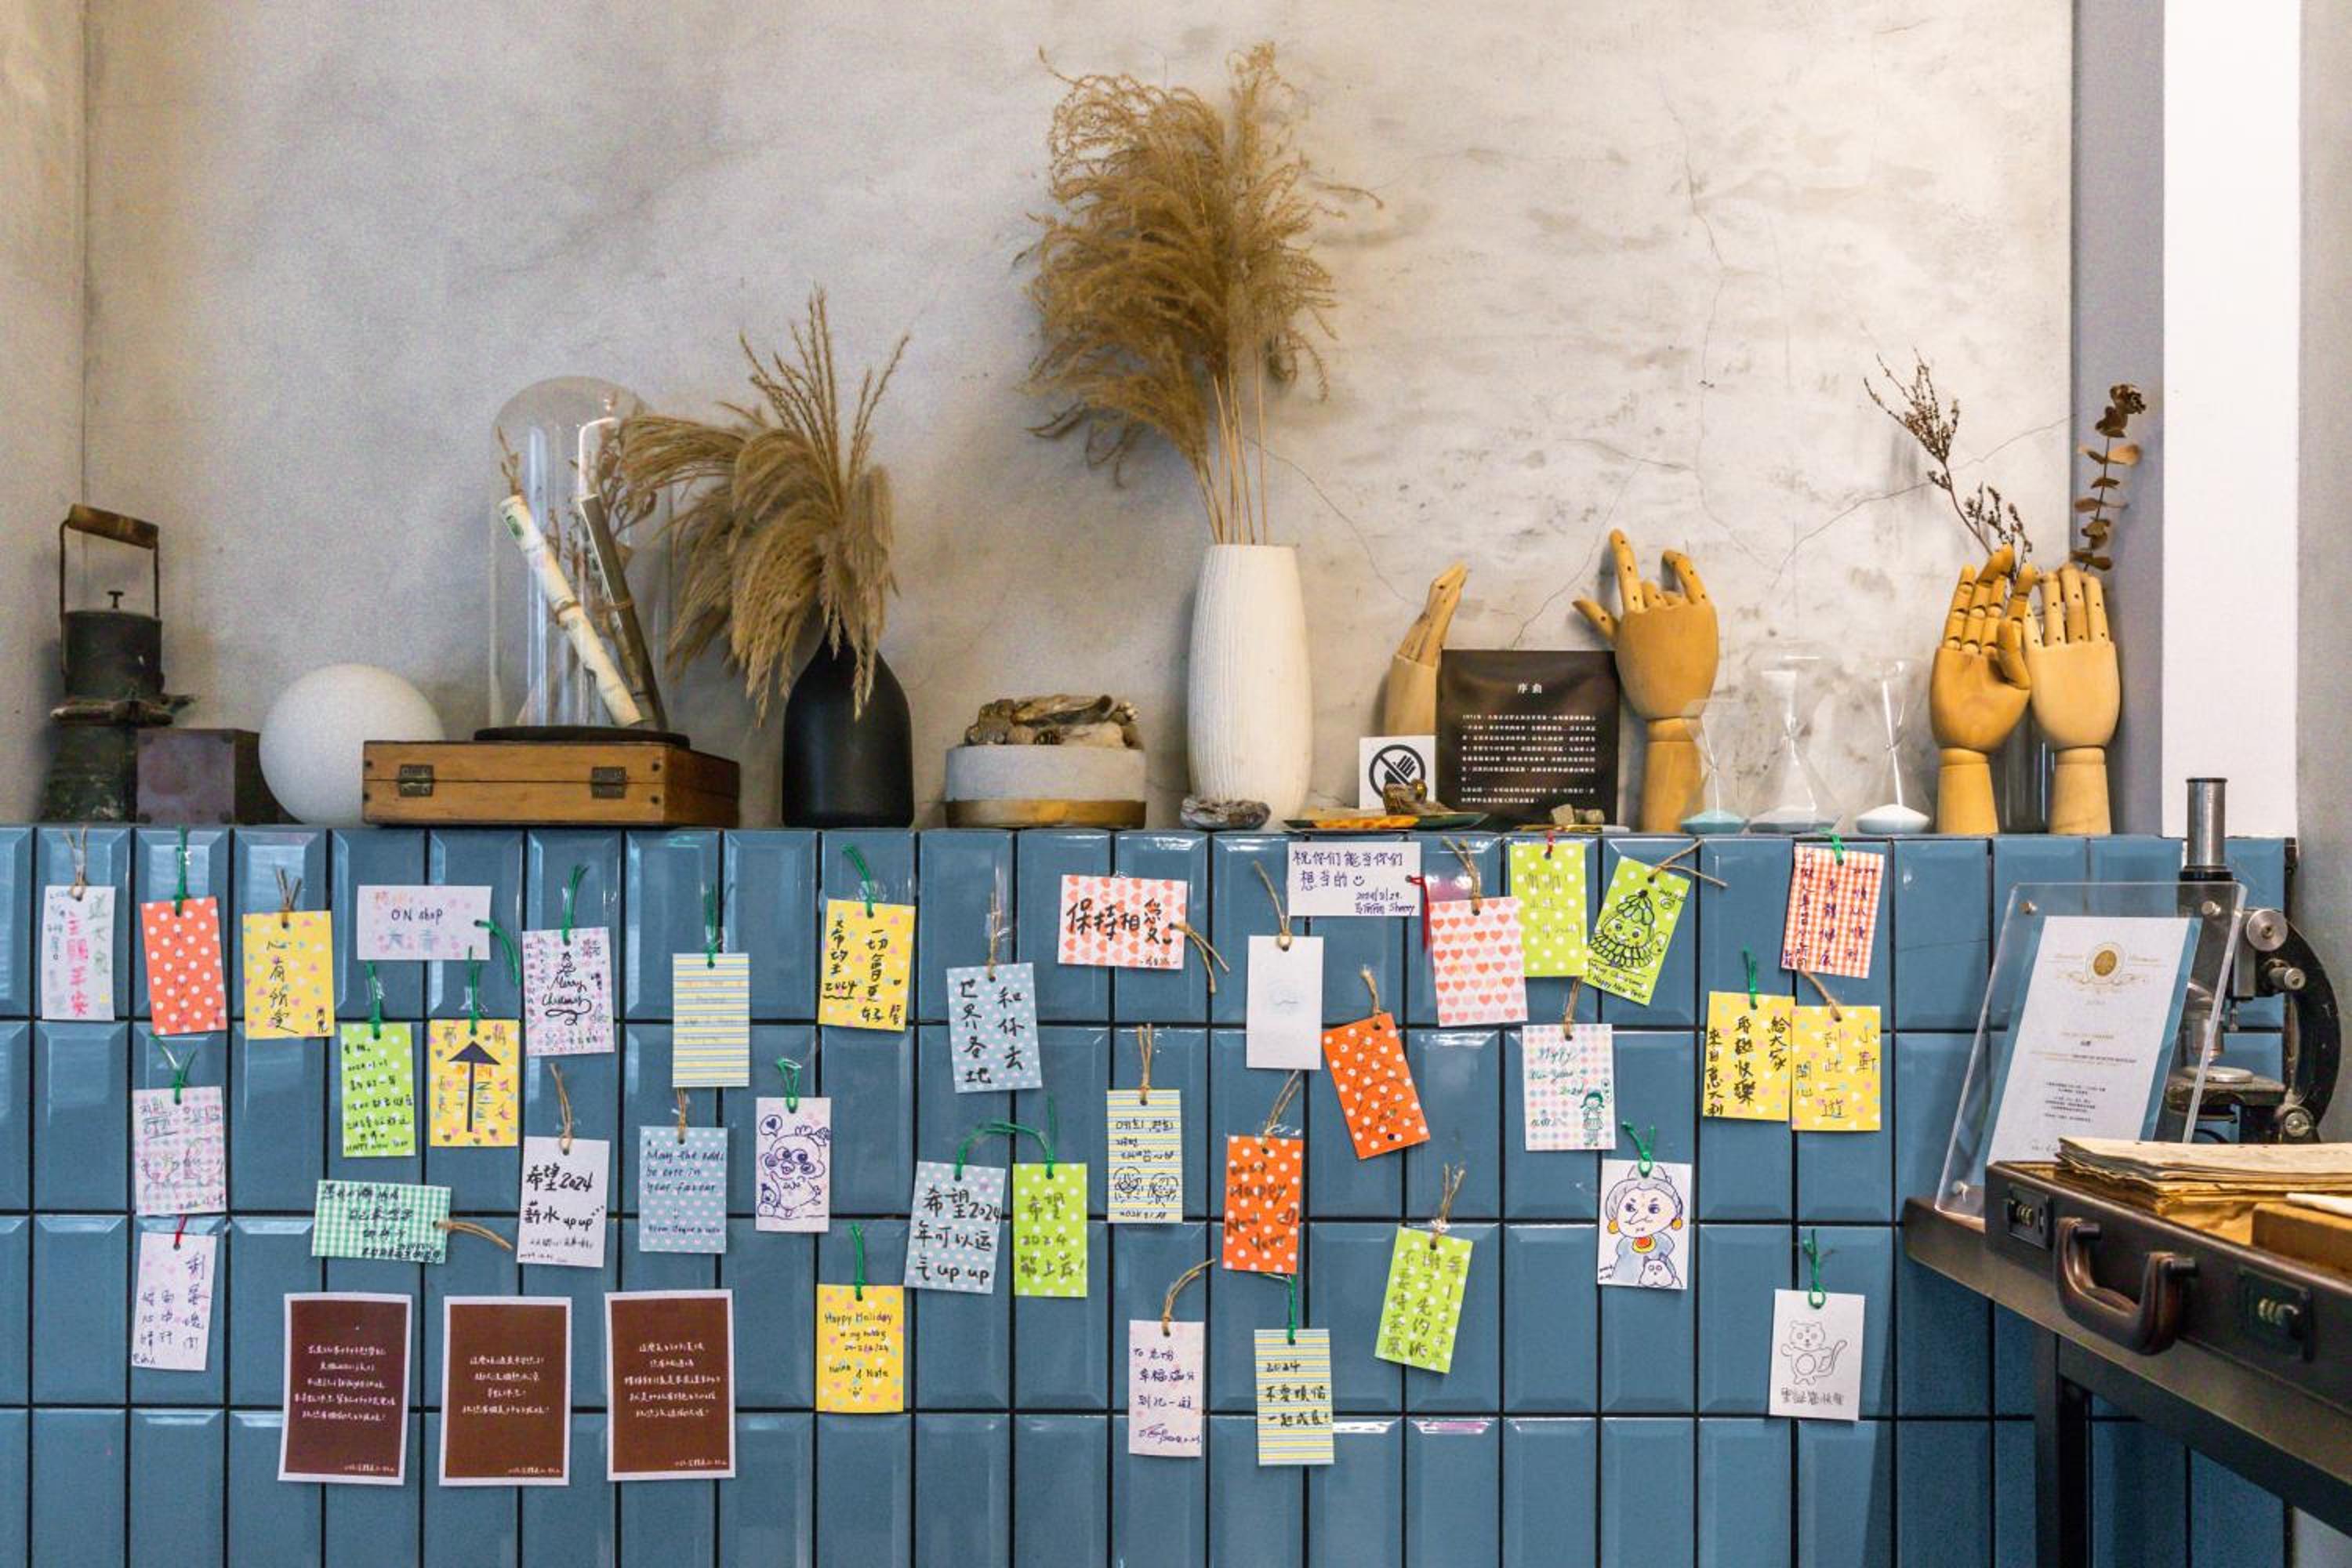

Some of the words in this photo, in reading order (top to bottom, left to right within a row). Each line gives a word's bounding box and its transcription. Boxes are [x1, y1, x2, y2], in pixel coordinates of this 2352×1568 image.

[937, 1265, 960, 1283] up
[968, 1269, 989, 1285] up
[825, 1312, 852, 1325] Happy
